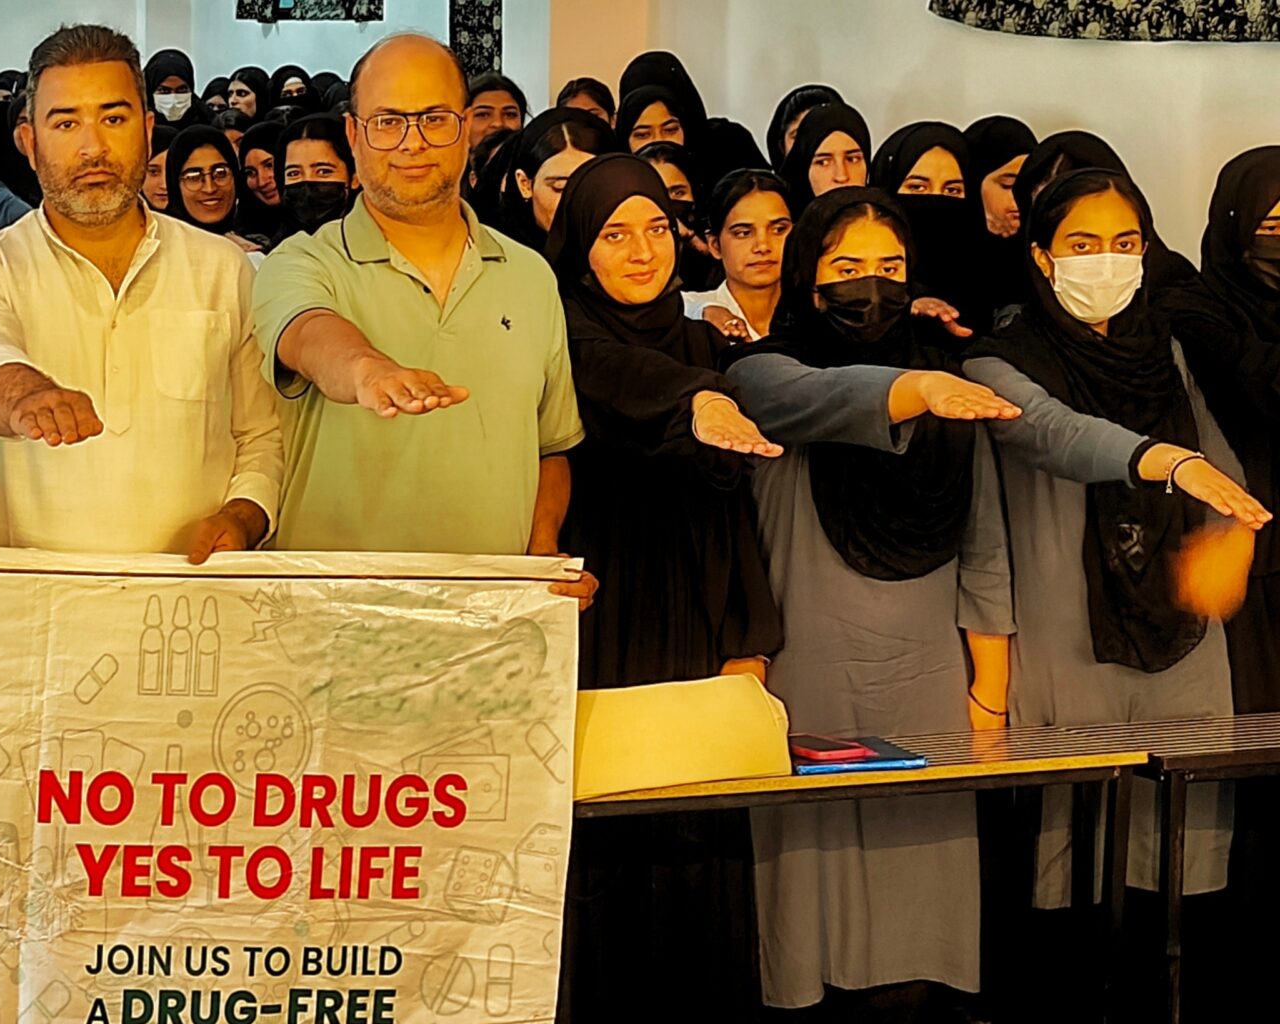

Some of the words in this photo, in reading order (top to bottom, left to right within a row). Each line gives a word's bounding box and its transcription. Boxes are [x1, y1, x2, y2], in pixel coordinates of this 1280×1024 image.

[37, 769, 135, 826] NO
[151, 772, 237, 827] TO
[253, 773, 468, 828] DRUGS
[75, 843, 192, 898] YES
[208, 845, 293, 900] TO
[309, 846, 422, 900] LIFE
[85, 944, 172, 976] JOIN
[185, 945, 230, 977] US
[243, 946, 290, 977] TO
[302, 945, 403, 976] BUILD
